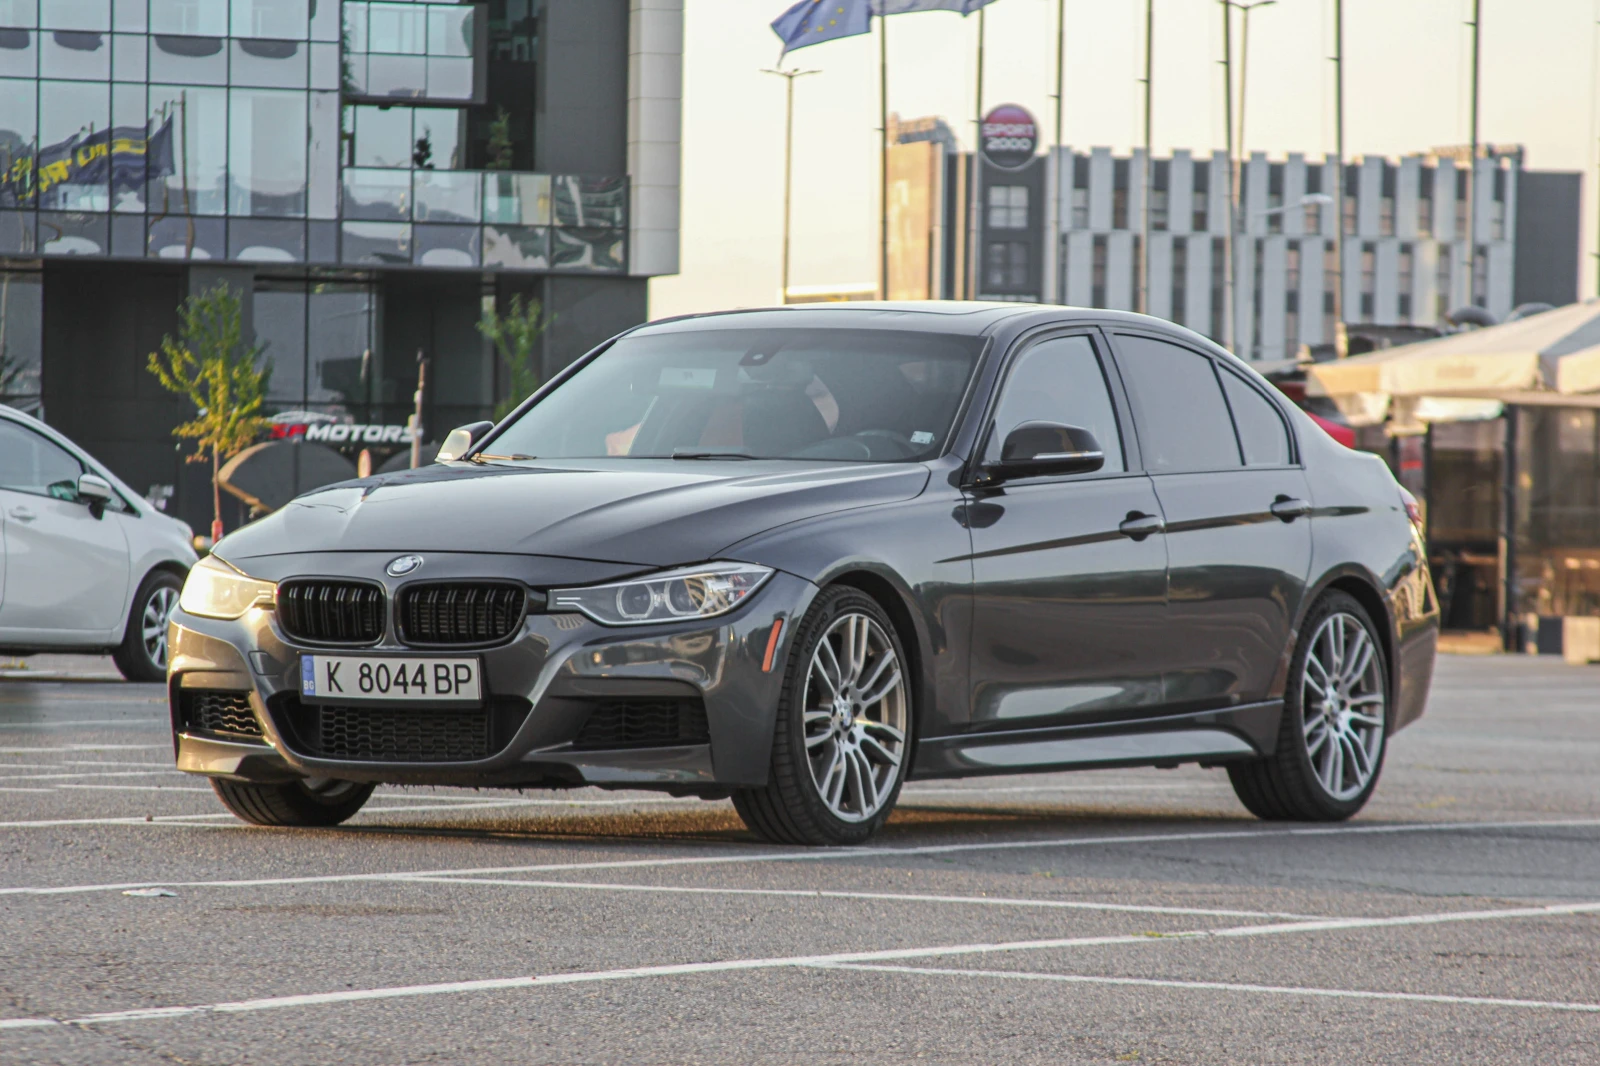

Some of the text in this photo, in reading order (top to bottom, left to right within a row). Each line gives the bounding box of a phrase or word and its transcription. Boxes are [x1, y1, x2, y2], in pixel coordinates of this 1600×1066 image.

[983, 123, 1034, 137] SPORT
[986, 137, 1032, 150] 2000
[305, 424, 424, 442] MOTORS
[326, 661, 344, 693] K
[303, 680, 315, 691] BG
